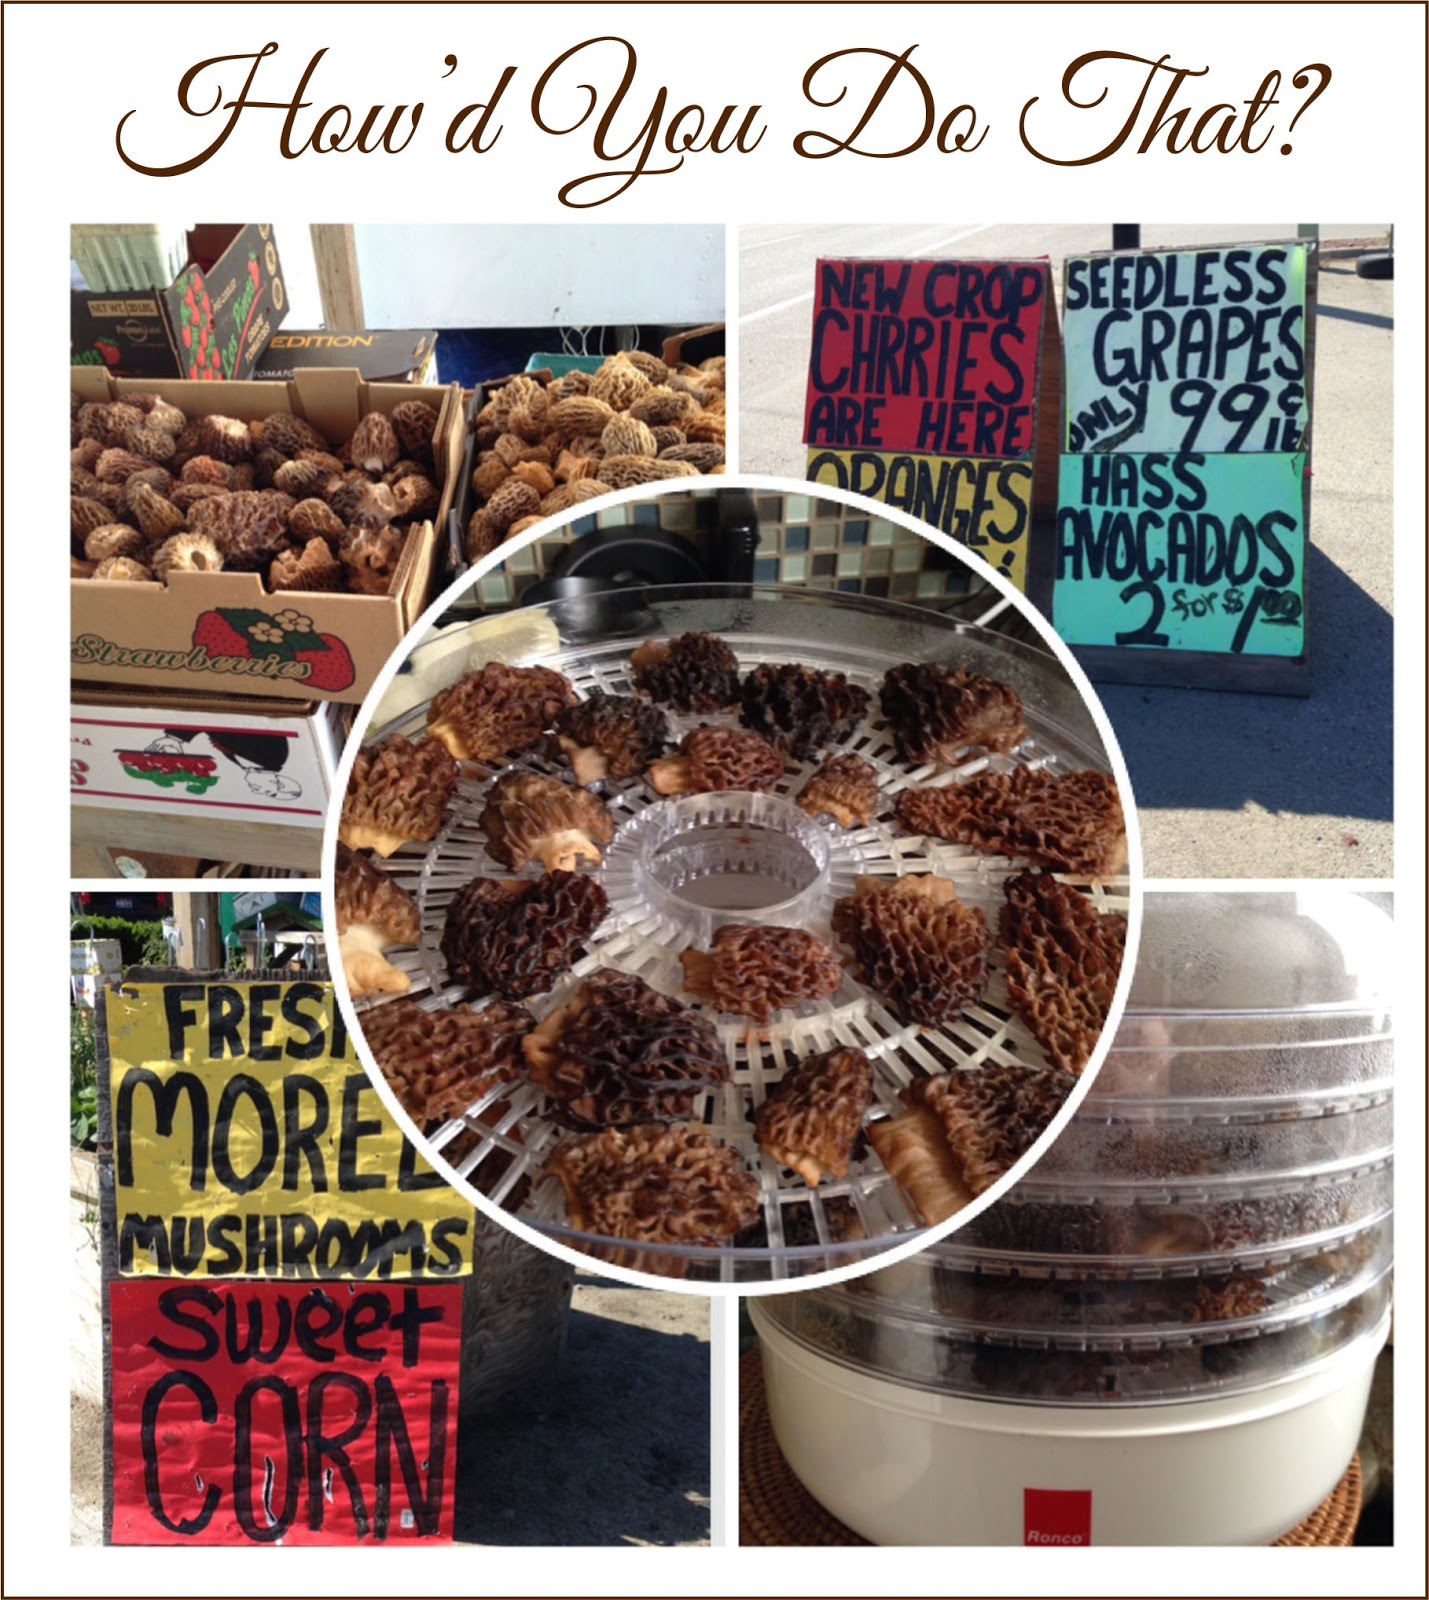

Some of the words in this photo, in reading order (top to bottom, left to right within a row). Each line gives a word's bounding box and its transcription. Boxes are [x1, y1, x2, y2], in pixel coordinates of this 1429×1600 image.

[821, 263, 912, 313] NEW
[924, 263, 1043, 324] CROP
[1066, 249, 1288, 311] SEEDLESS
[811, 309, 1025, 406] CHRRIES
[1093, 305, 1304, 386] GRAPES
[807, 395, 886, 446] ARE
[916, 401, 1030, 456] HERE
[1082, 453, 1207, 511] HASS
[1056, 506, 1298, 588] AVOCADOS
[1115, 581, 1169, 647] 2
[1171, 588, 1218, 621] for
[70, 633, 312, 679] Strawberries
[119, 1212, 469, 1278] MUSHROOMS
[142, 1369, 449, 1542] CORN
[1027, 1530, 1083, 1545] Ronco
